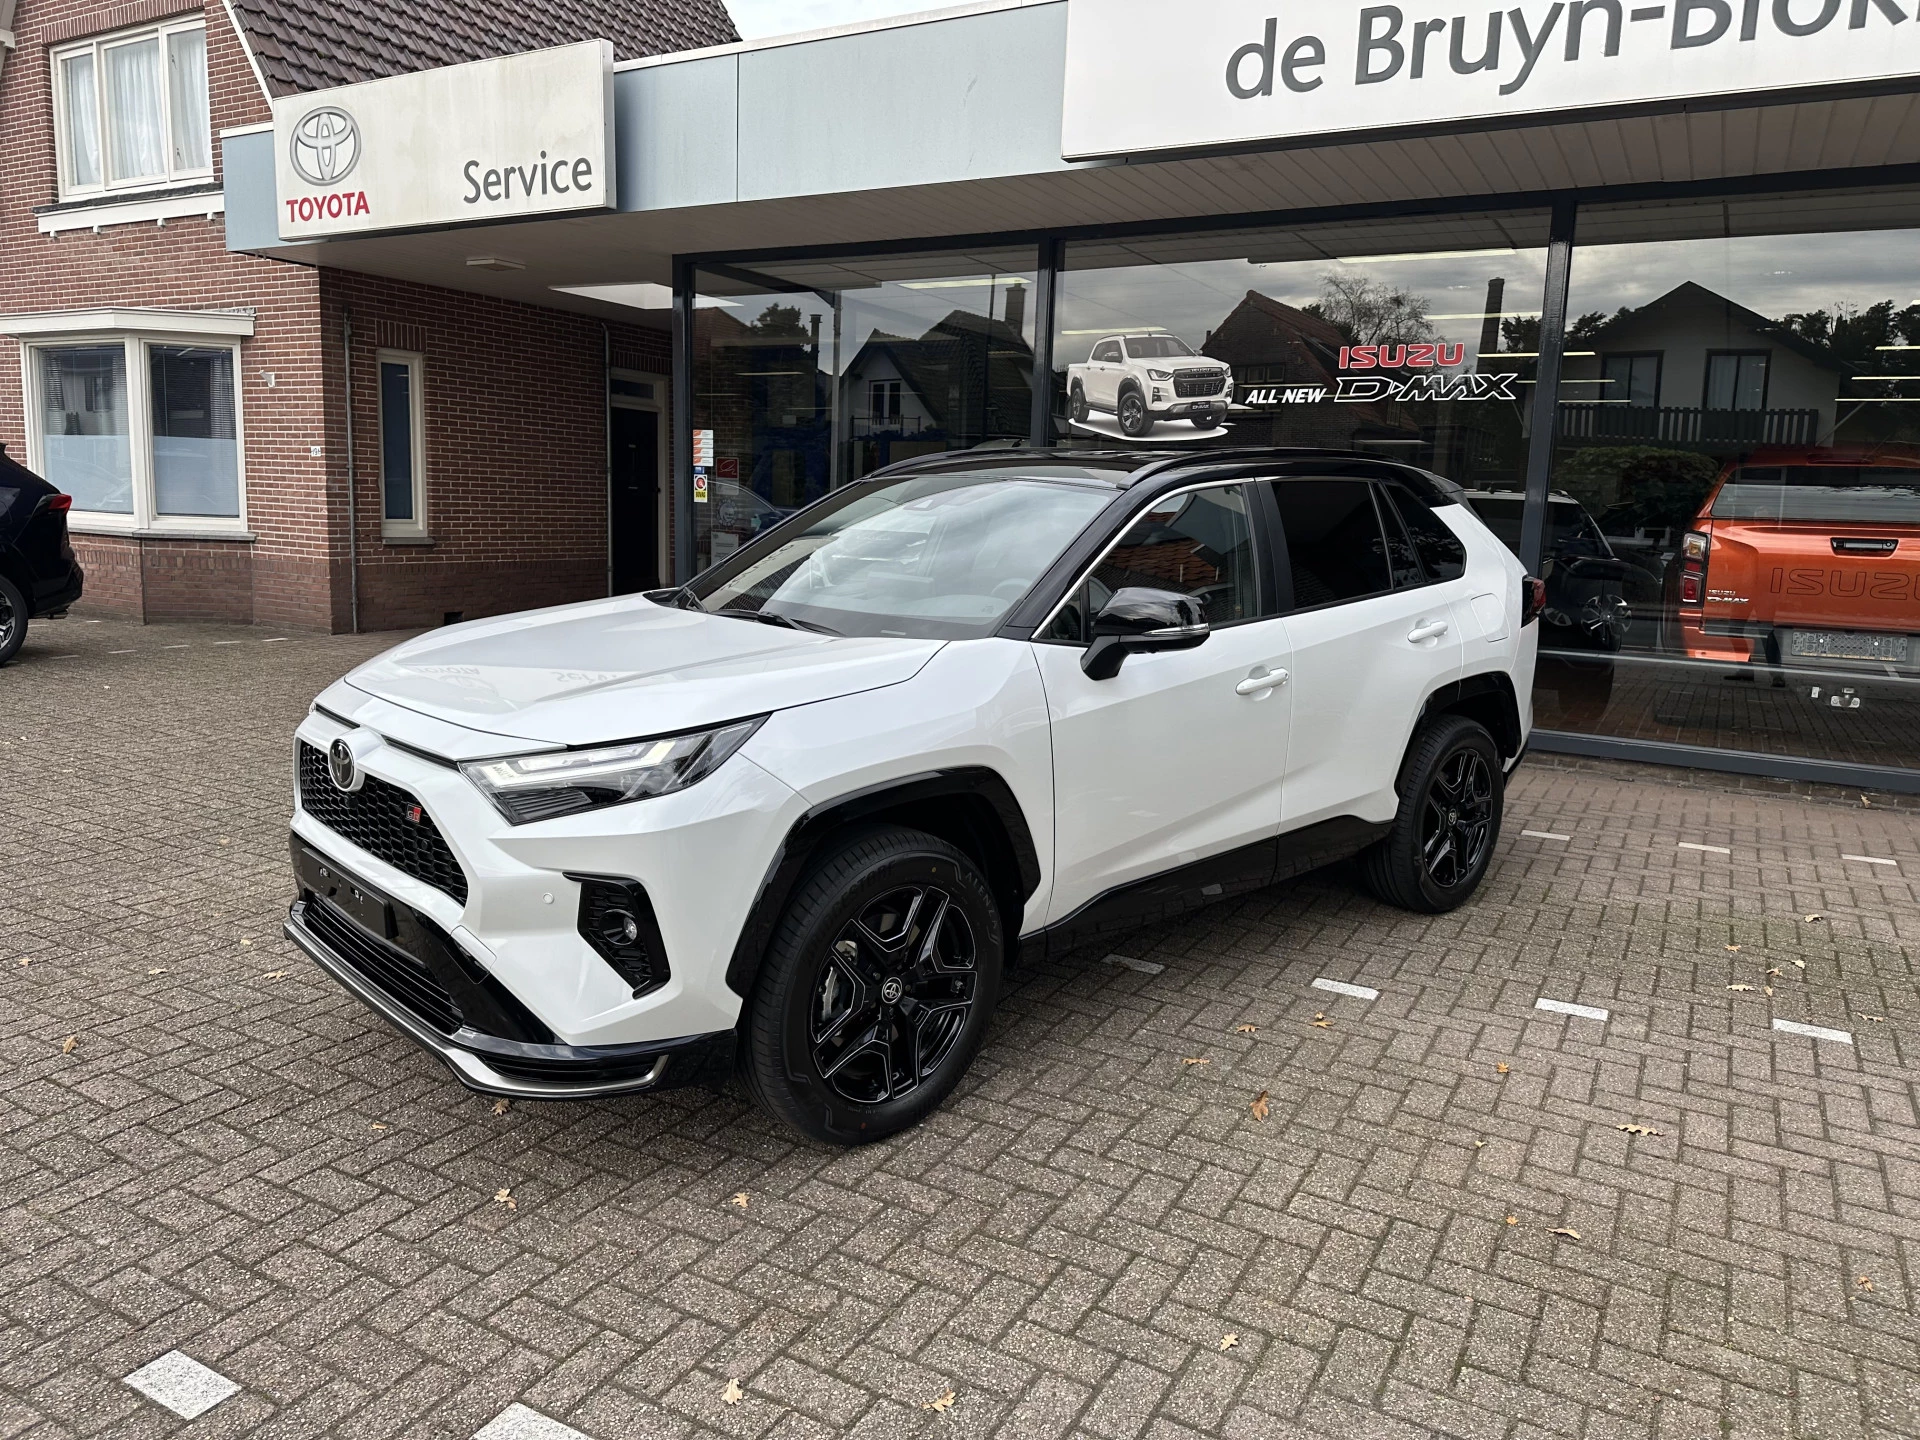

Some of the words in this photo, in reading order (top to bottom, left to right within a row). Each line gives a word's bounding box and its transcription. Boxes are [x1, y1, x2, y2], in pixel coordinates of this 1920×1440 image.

[1225, 17, 1326, 99] de
[1354, 0, 1920, 96] Bruyn-Bo
[463, 150, 593, 204] Service
[285, 190, 371, 223] TOYOTA
[1338, 342, 1465, 369] ISUZU
[1244, 389, 1278, 404] ALL
[1281, 387, 1327, 404] NEW
[1769, 567, 1920, 600] ISUZ
[965, 871, 998, 930] ALENZA
